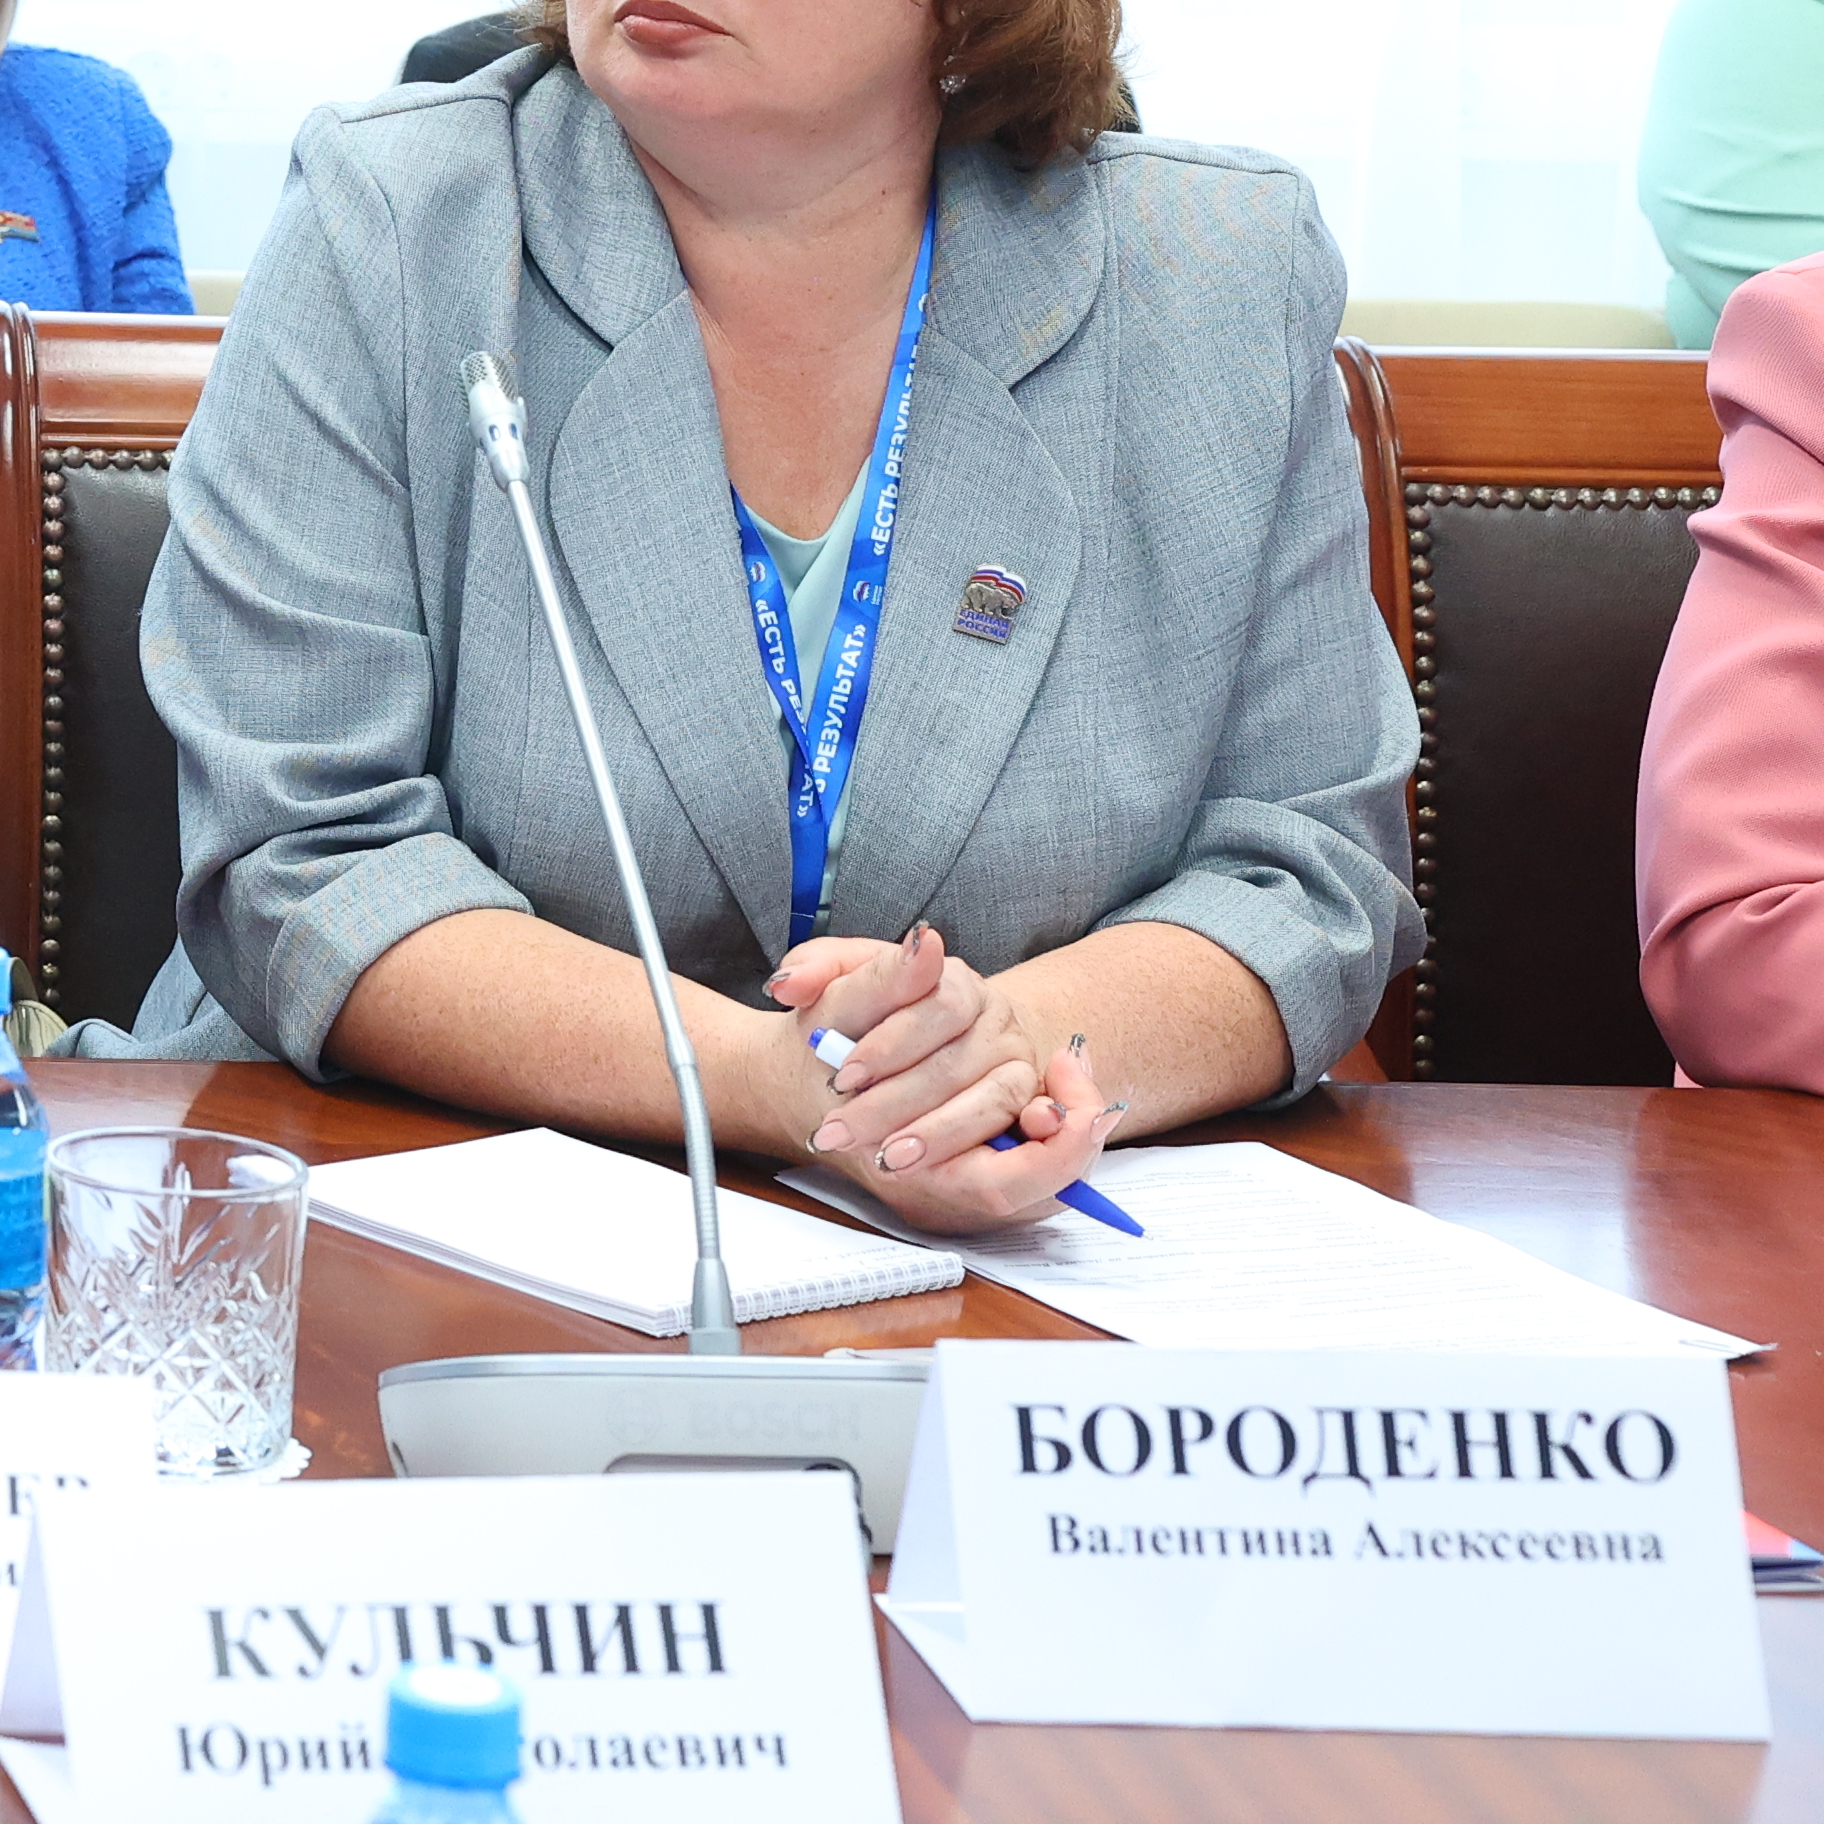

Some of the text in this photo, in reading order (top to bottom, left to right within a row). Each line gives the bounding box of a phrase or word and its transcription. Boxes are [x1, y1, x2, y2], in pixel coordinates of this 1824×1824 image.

[872, 483, 900, 558] «ЕСТЬ
[755, 598, 788, 675] «ЕСТЬ
[813, 623, 867, 774] РЕЗУЛЬТАТ»
[1012, 1403, 1678, 1500] БОРОДЕНКО
[1047, 1511, 1665, 1564] Валентина Алексеевна
[207, 1601, 734, 1678] КУЛЬЧИН
[176, 1721, 372, 1788] Юрий
